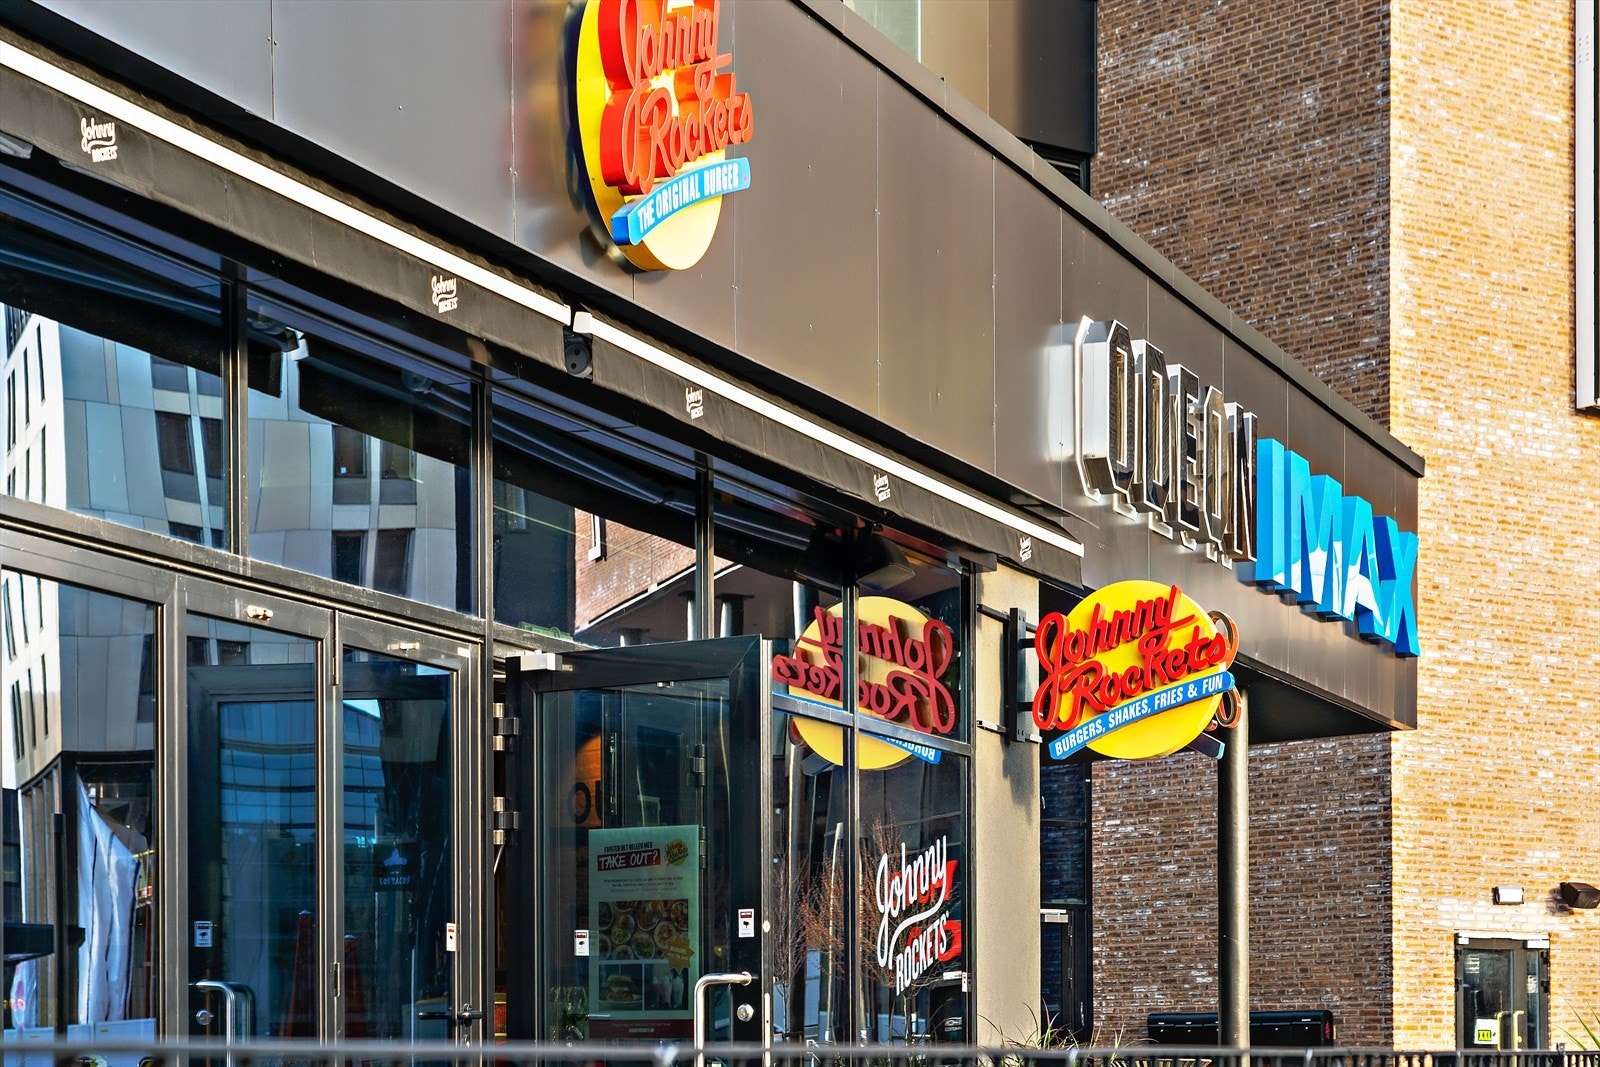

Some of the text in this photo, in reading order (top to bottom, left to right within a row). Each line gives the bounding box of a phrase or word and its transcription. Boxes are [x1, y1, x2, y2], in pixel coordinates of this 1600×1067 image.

[81, 117, 116, 154] Johnny
[638, 73, 753, 194] Rockets
[637, 162, 739, 234] THE ORIGINAL BURGER
[431, 274, 457, 306] Johnny
[1104, 319, 1421, 658] ODEON IMAX
[1032, 584, 1199, 731] Johnny
[1056, 625, 1228, 731] Rockets
[1054, 674, 1224, 757] BURGERS, SHAKES, FRIES & FUN
[598, 854, 627, 870] TAKE
[629, 849, 659, 866] OUT?
[875, 834, 947, 970] Johnny
